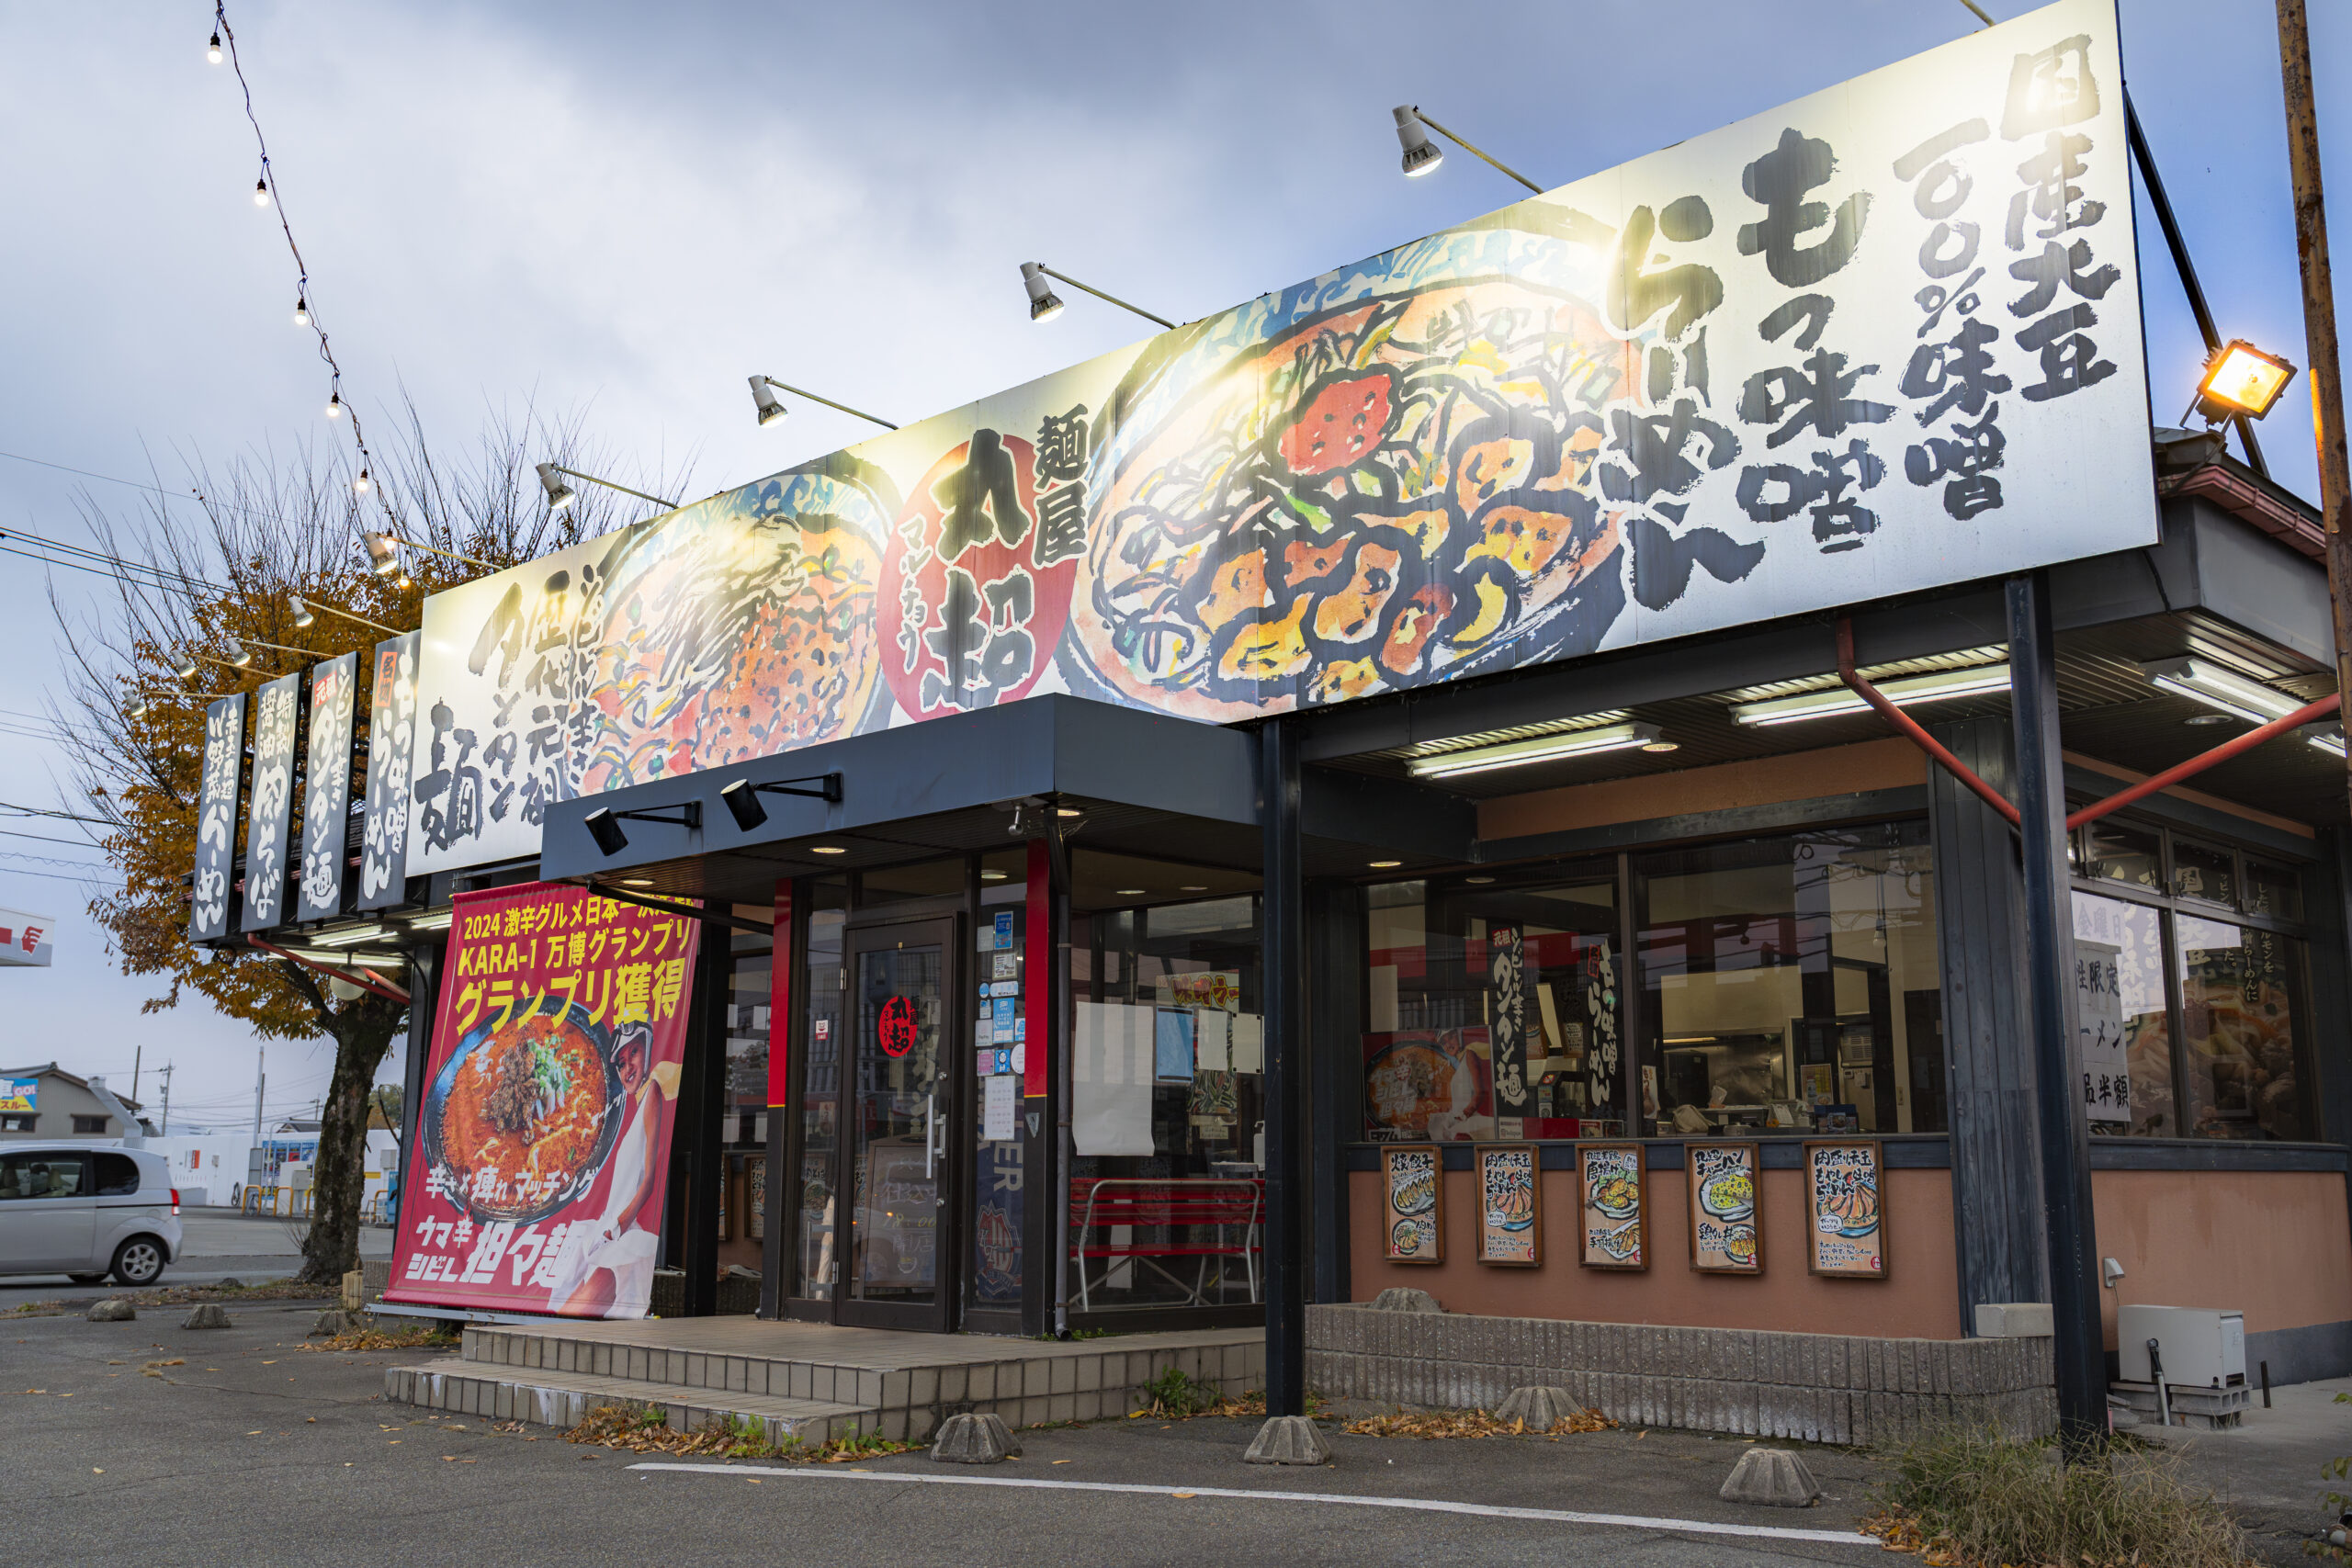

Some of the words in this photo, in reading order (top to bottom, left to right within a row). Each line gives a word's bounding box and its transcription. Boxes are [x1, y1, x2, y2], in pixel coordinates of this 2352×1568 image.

[2001, 33, 2120, 401] 国産大豆
[1598, 195, 1766, 612] らーめん
[1034, 402, 1089, 567] 麺屋
[259, 687, 277, 761] 醤油
[315, 673, 337, 705] 元祖
[252, 757, 288, 920] 肉そば
[301, 705, 338, 909] タンタン麺
[363, 708, 392, 899] らーめん
[414, 697, 483, 856] 麺
[455, 956, 686, 1036] グランプリ獲得
[457, 938, 537, 978] KARA-1
[546, 919, 692, 970] 万博グランプリ
[464, 914, 501, 941] 2024
[1493, 930, 1511, 947] 元祖
[2076, 901, 2122, 941] 金曜日
[1493, 952, 1527, 1107] タンタン麺
